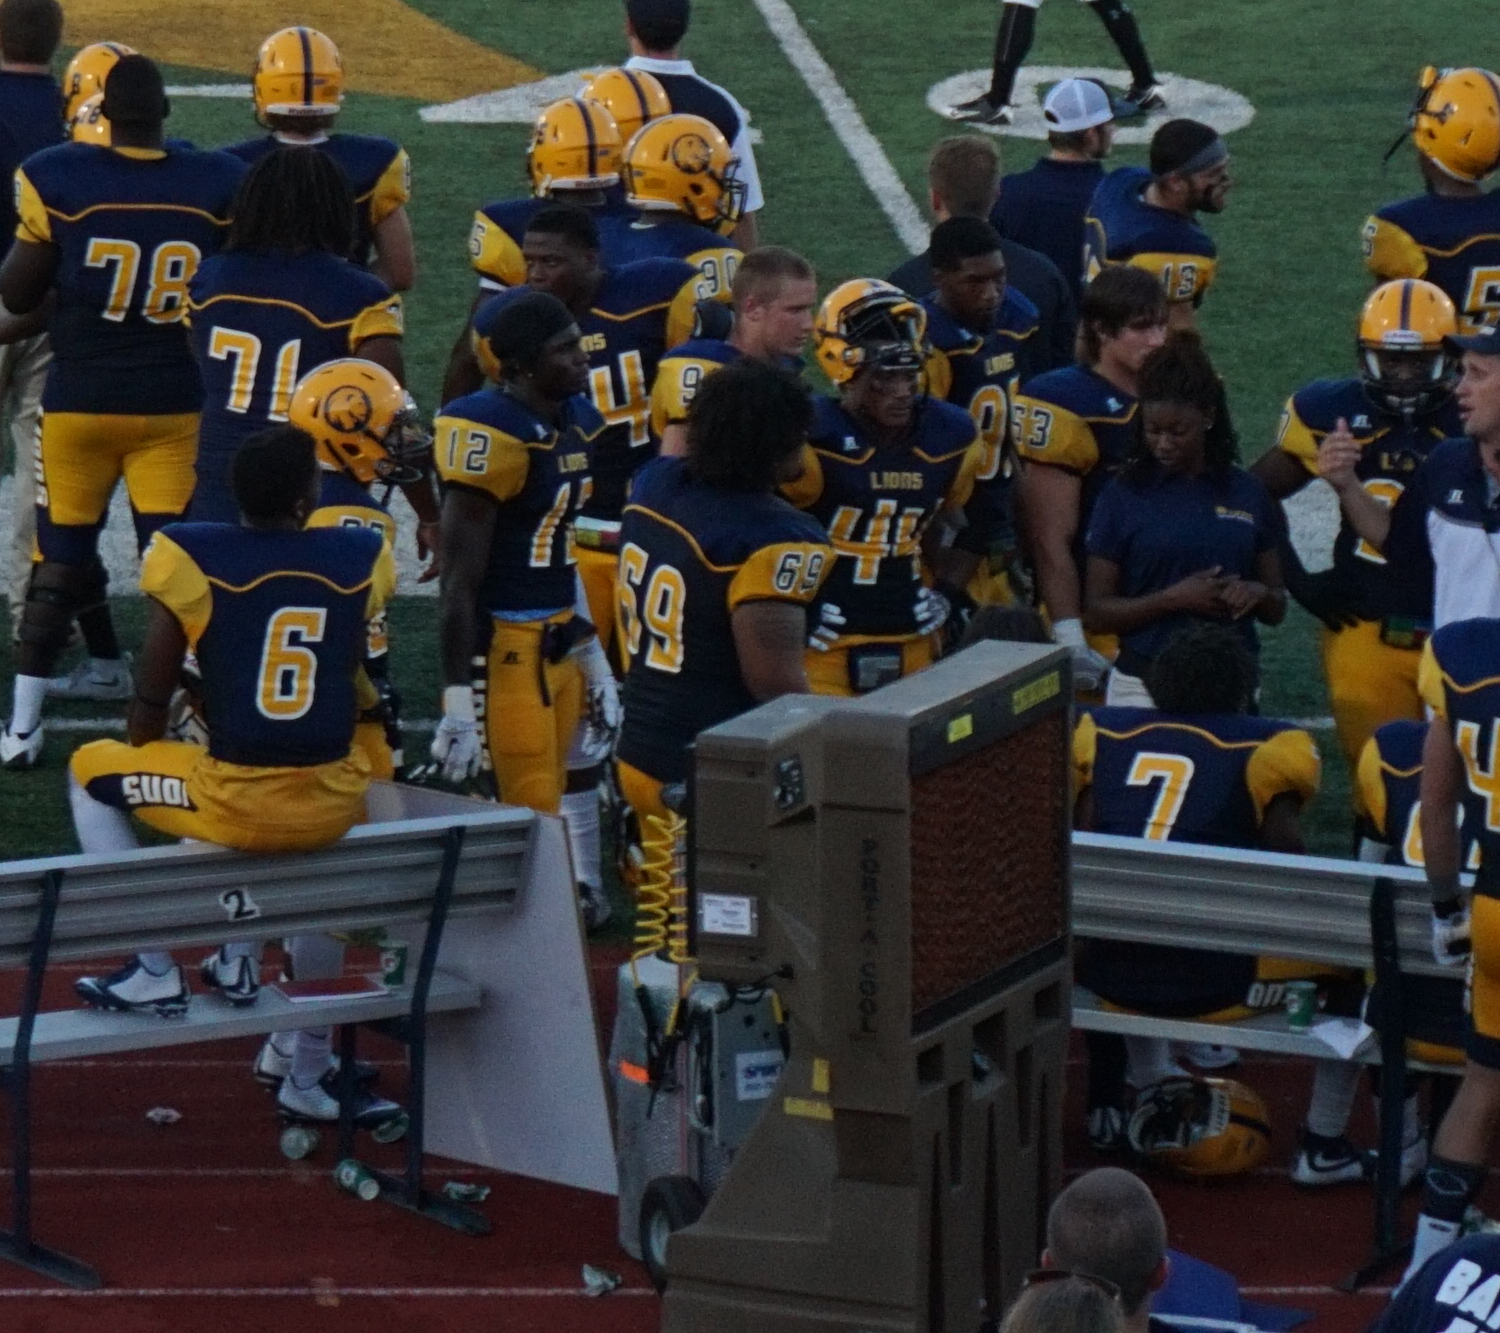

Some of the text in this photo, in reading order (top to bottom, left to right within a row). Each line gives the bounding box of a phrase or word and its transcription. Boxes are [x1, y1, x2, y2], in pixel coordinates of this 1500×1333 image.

[85, 236, 202, 324] 78
[1163, 262, 1200, 300] 13
[447, 429, 491, 475] 12
[869, 471, 924, 491] LIONS
[772, 549, 826, 595] 69
[616, 541, 687, 674] 69
[255, 605, 328, 721] 6
[121, 771, 192, 809] IONS
[1126, 750, 1195, 842] 7
[220, 889, 261, 923] 2
